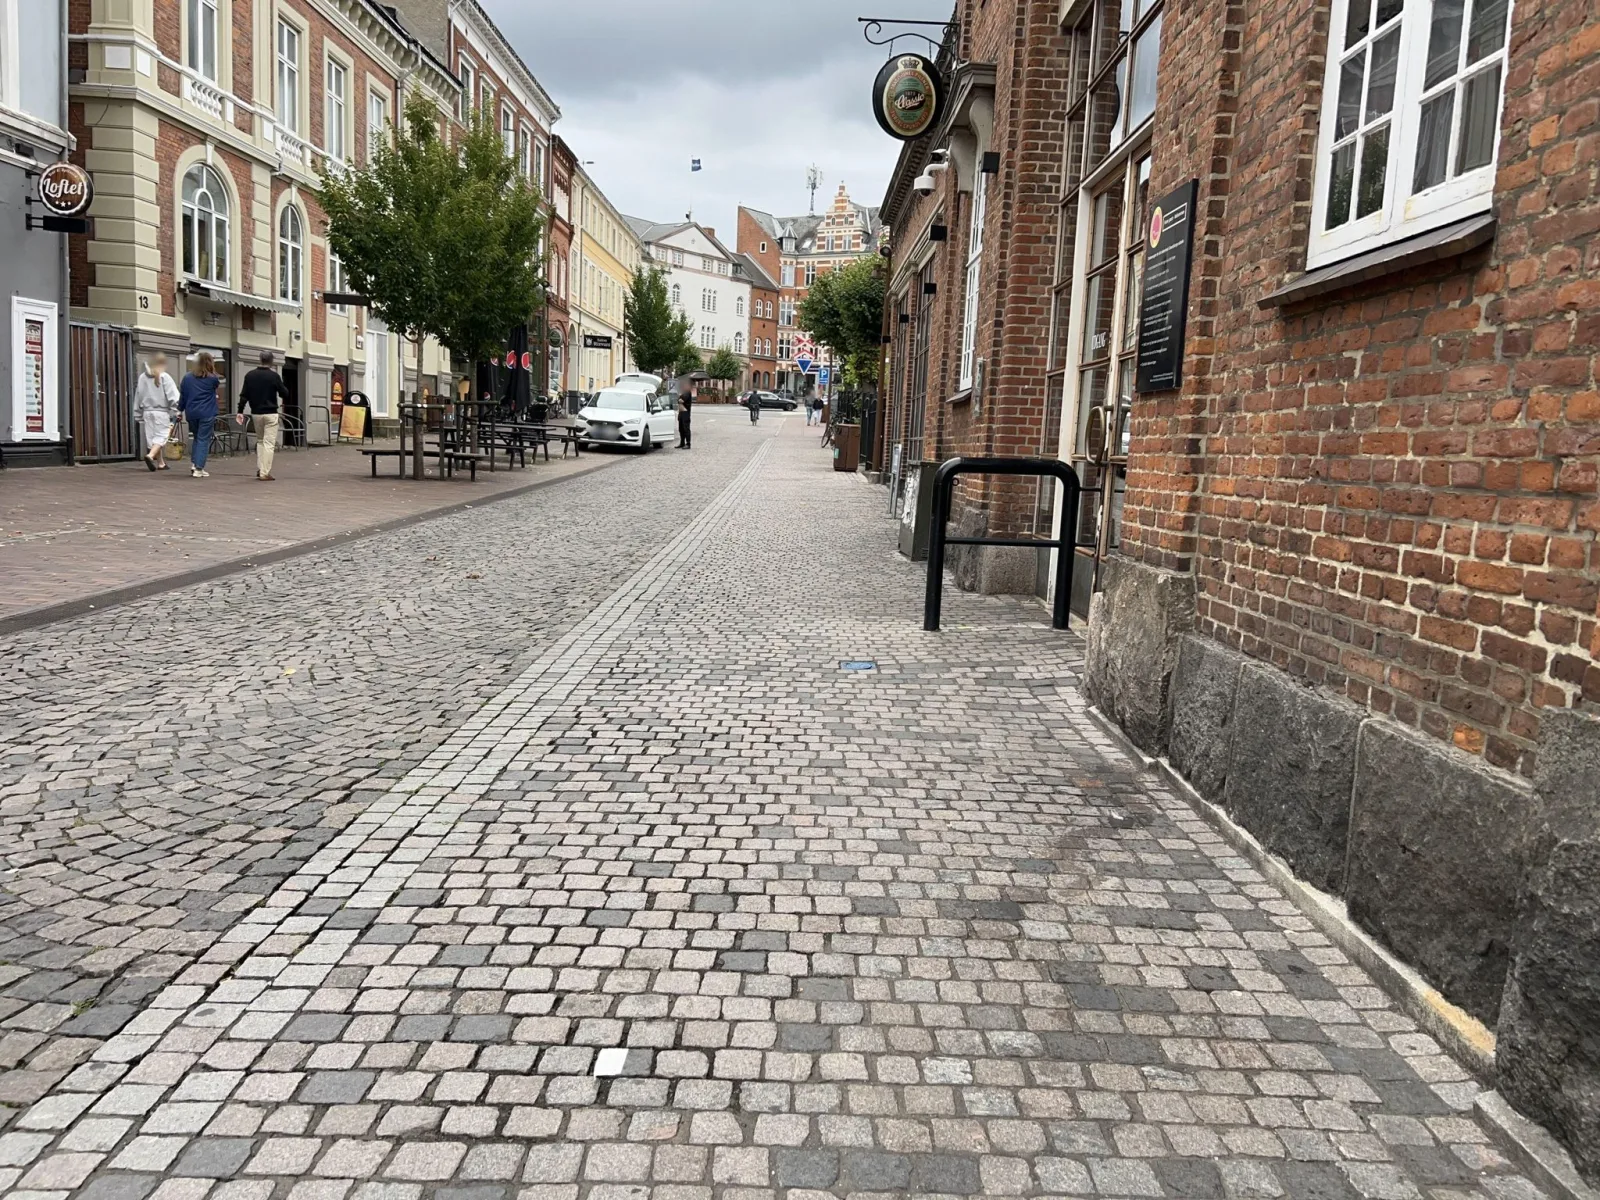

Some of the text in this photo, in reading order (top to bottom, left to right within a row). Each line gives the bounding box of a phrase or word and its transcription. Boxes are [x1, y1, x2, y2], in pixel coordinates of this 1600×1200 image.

[894, 93, 925, 109] Classic
[43, 178, 83, 198] Loftet
[138, 295, 149, 309] 13
[821, 370, 827, 378] P
